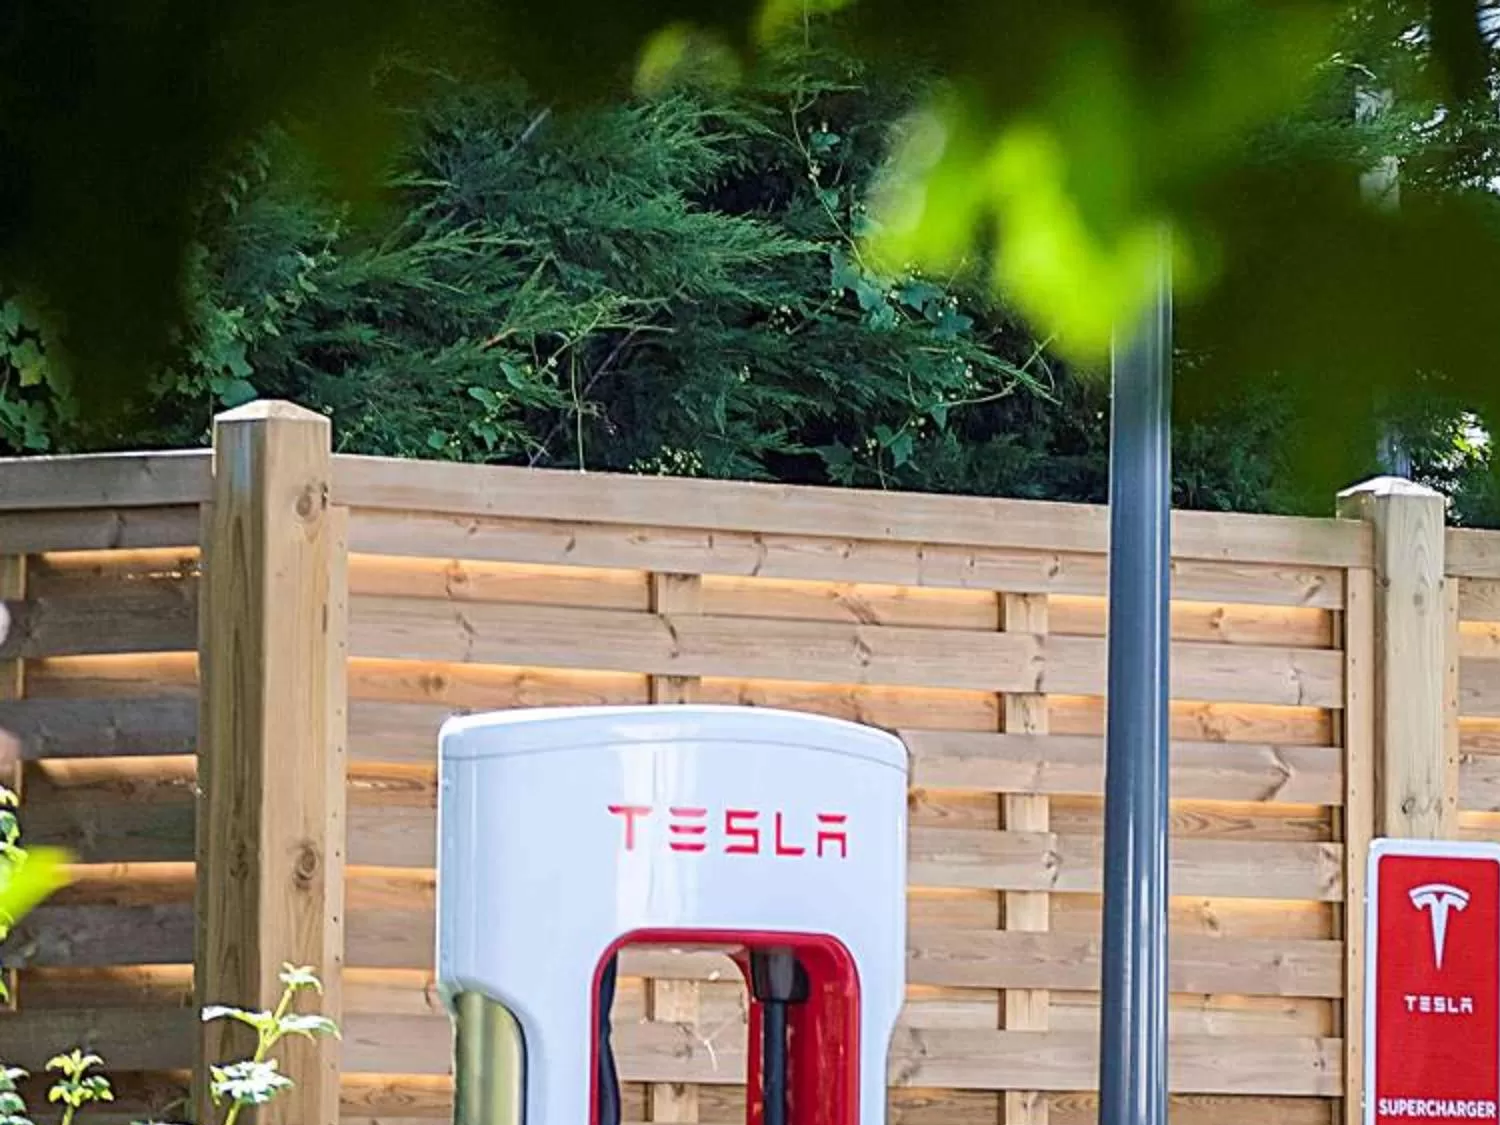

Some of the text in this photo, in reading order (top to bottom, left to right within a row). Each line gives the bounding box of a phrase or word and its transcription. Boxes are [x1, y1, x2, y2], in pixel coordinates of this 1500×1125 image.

[607, 804, 848, 858] TESLA
[1404, 995, 1473, 1014] TESLA
[1378, 1098, 1497, 1119] SUPERCHARGER
